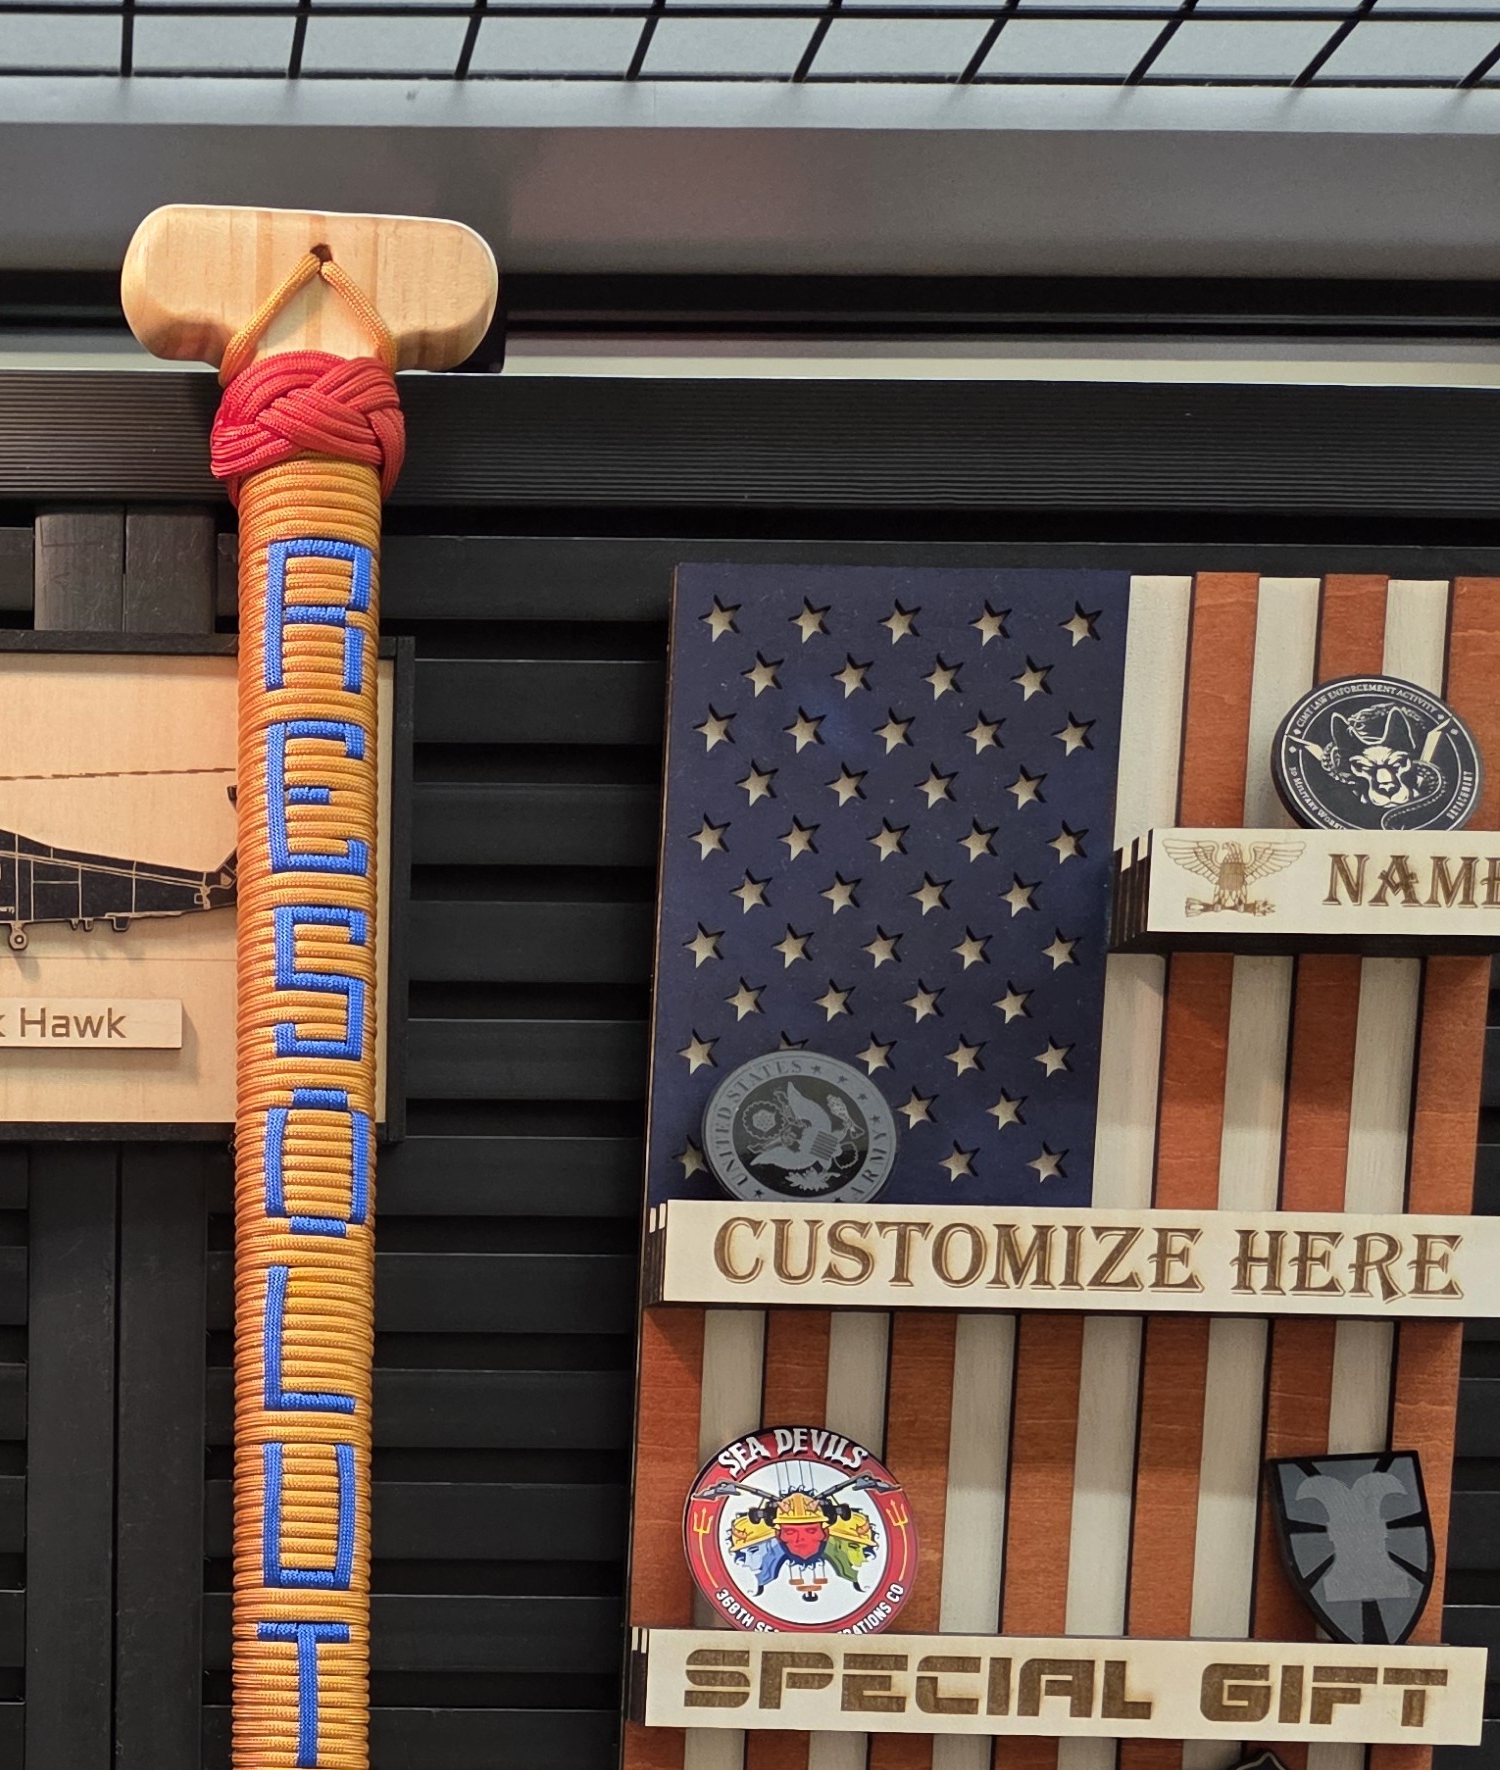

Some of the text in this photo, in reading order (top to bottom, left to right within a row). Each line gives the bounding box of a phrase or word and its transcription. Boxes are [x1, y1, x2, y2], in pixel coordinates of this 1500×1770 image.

[1311, 695, 1327, 709] LAW
[1328, 684, 1396, 700] ENFORCEMENT
[1397, 689, 1437, 714] ACTIVITY
[20, 1006, 127, 1040] Hawk
[727, 1060, 802, 1099] STATES
[715, 1107, 748, 1186] UNITED
[713, 1215, 1464, 1304] CUSTOMIZE HERE
[718, 1428, 868, 1478] SEA DEVILS
[716, 1589, 755, 1627] 368TH
[886, 1583, 904, 1603] CO
[683, 1649, 1448, 1728] SPECIAL GIFT
